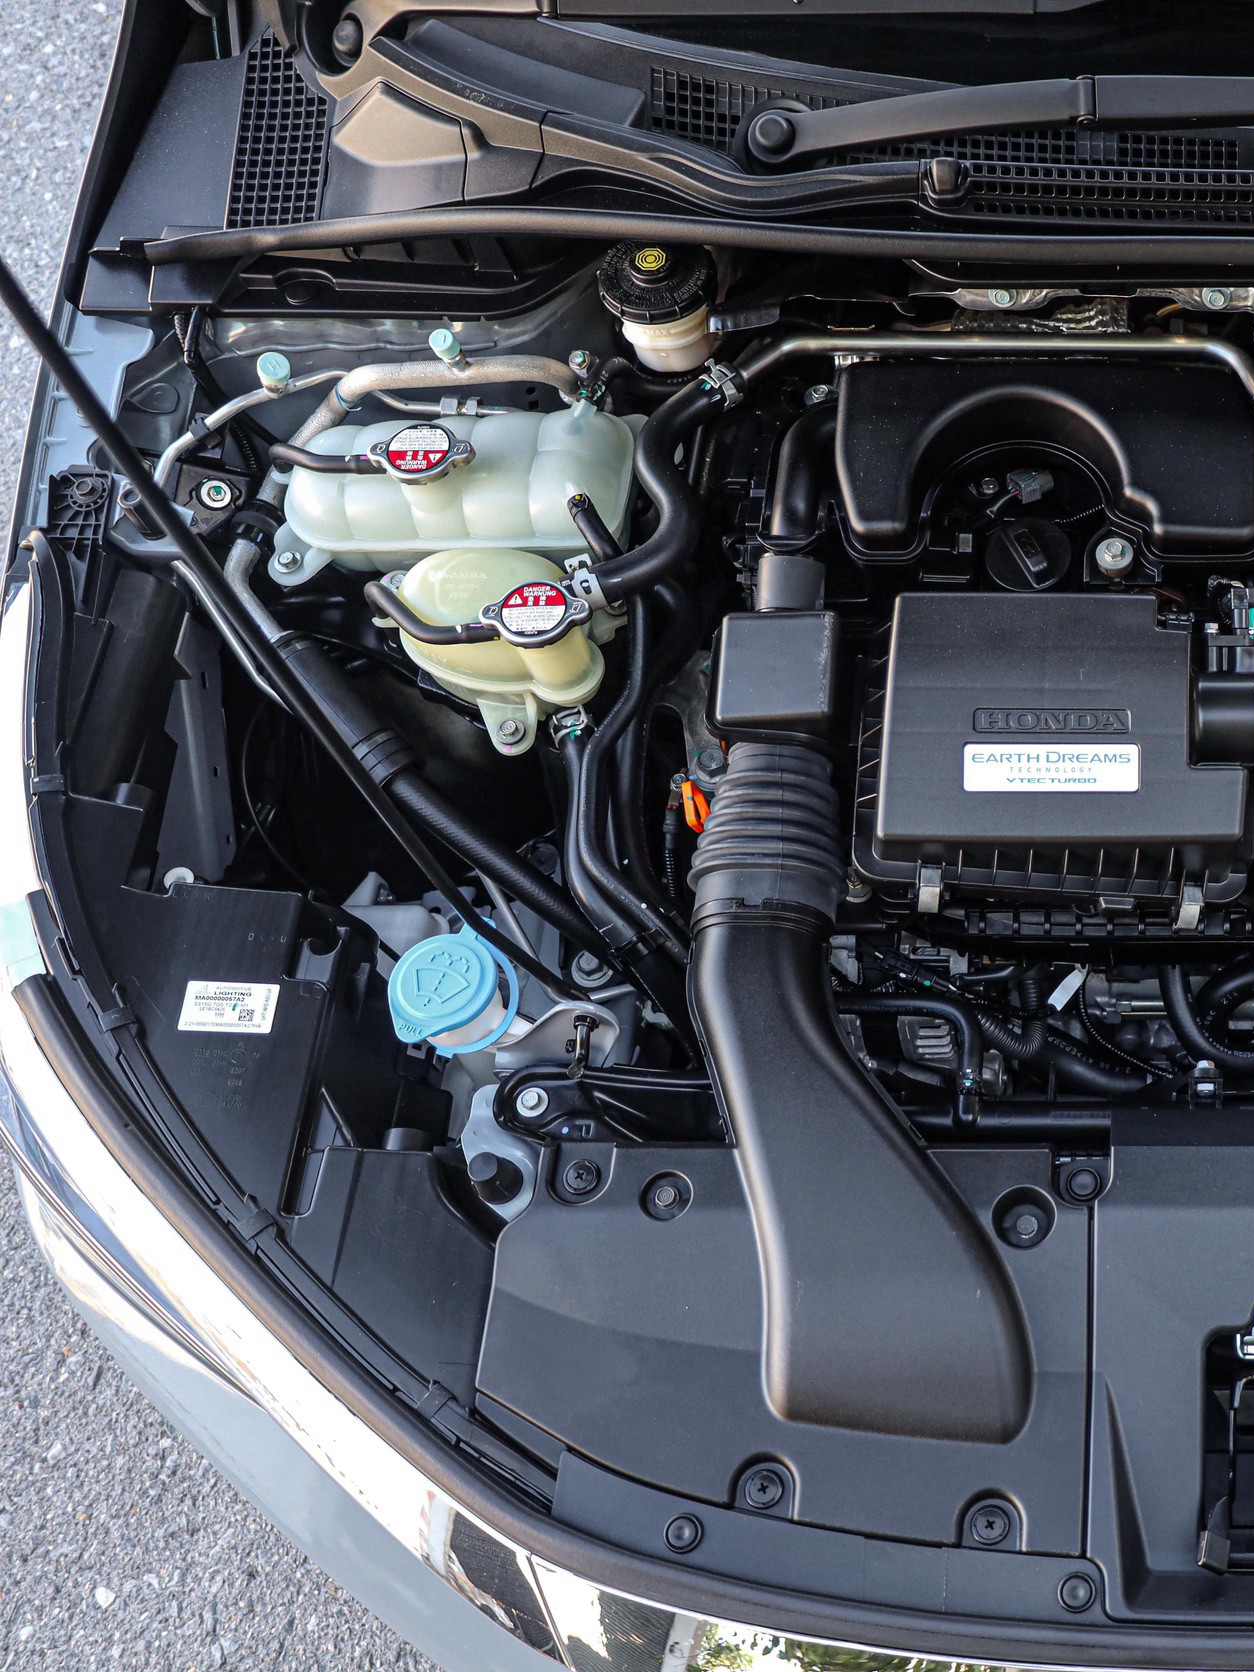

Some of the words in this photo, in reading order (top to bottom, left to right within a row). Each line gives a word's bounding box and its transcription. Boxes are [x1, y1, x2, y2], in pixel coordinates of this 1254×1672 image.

[980, 712, 1128, 730] HONDA
[972, 753, 1040, 764] EARTH
[1046, 751, 1131, 764] DREAMS
[399, 1024, 424, 1036] PULL
